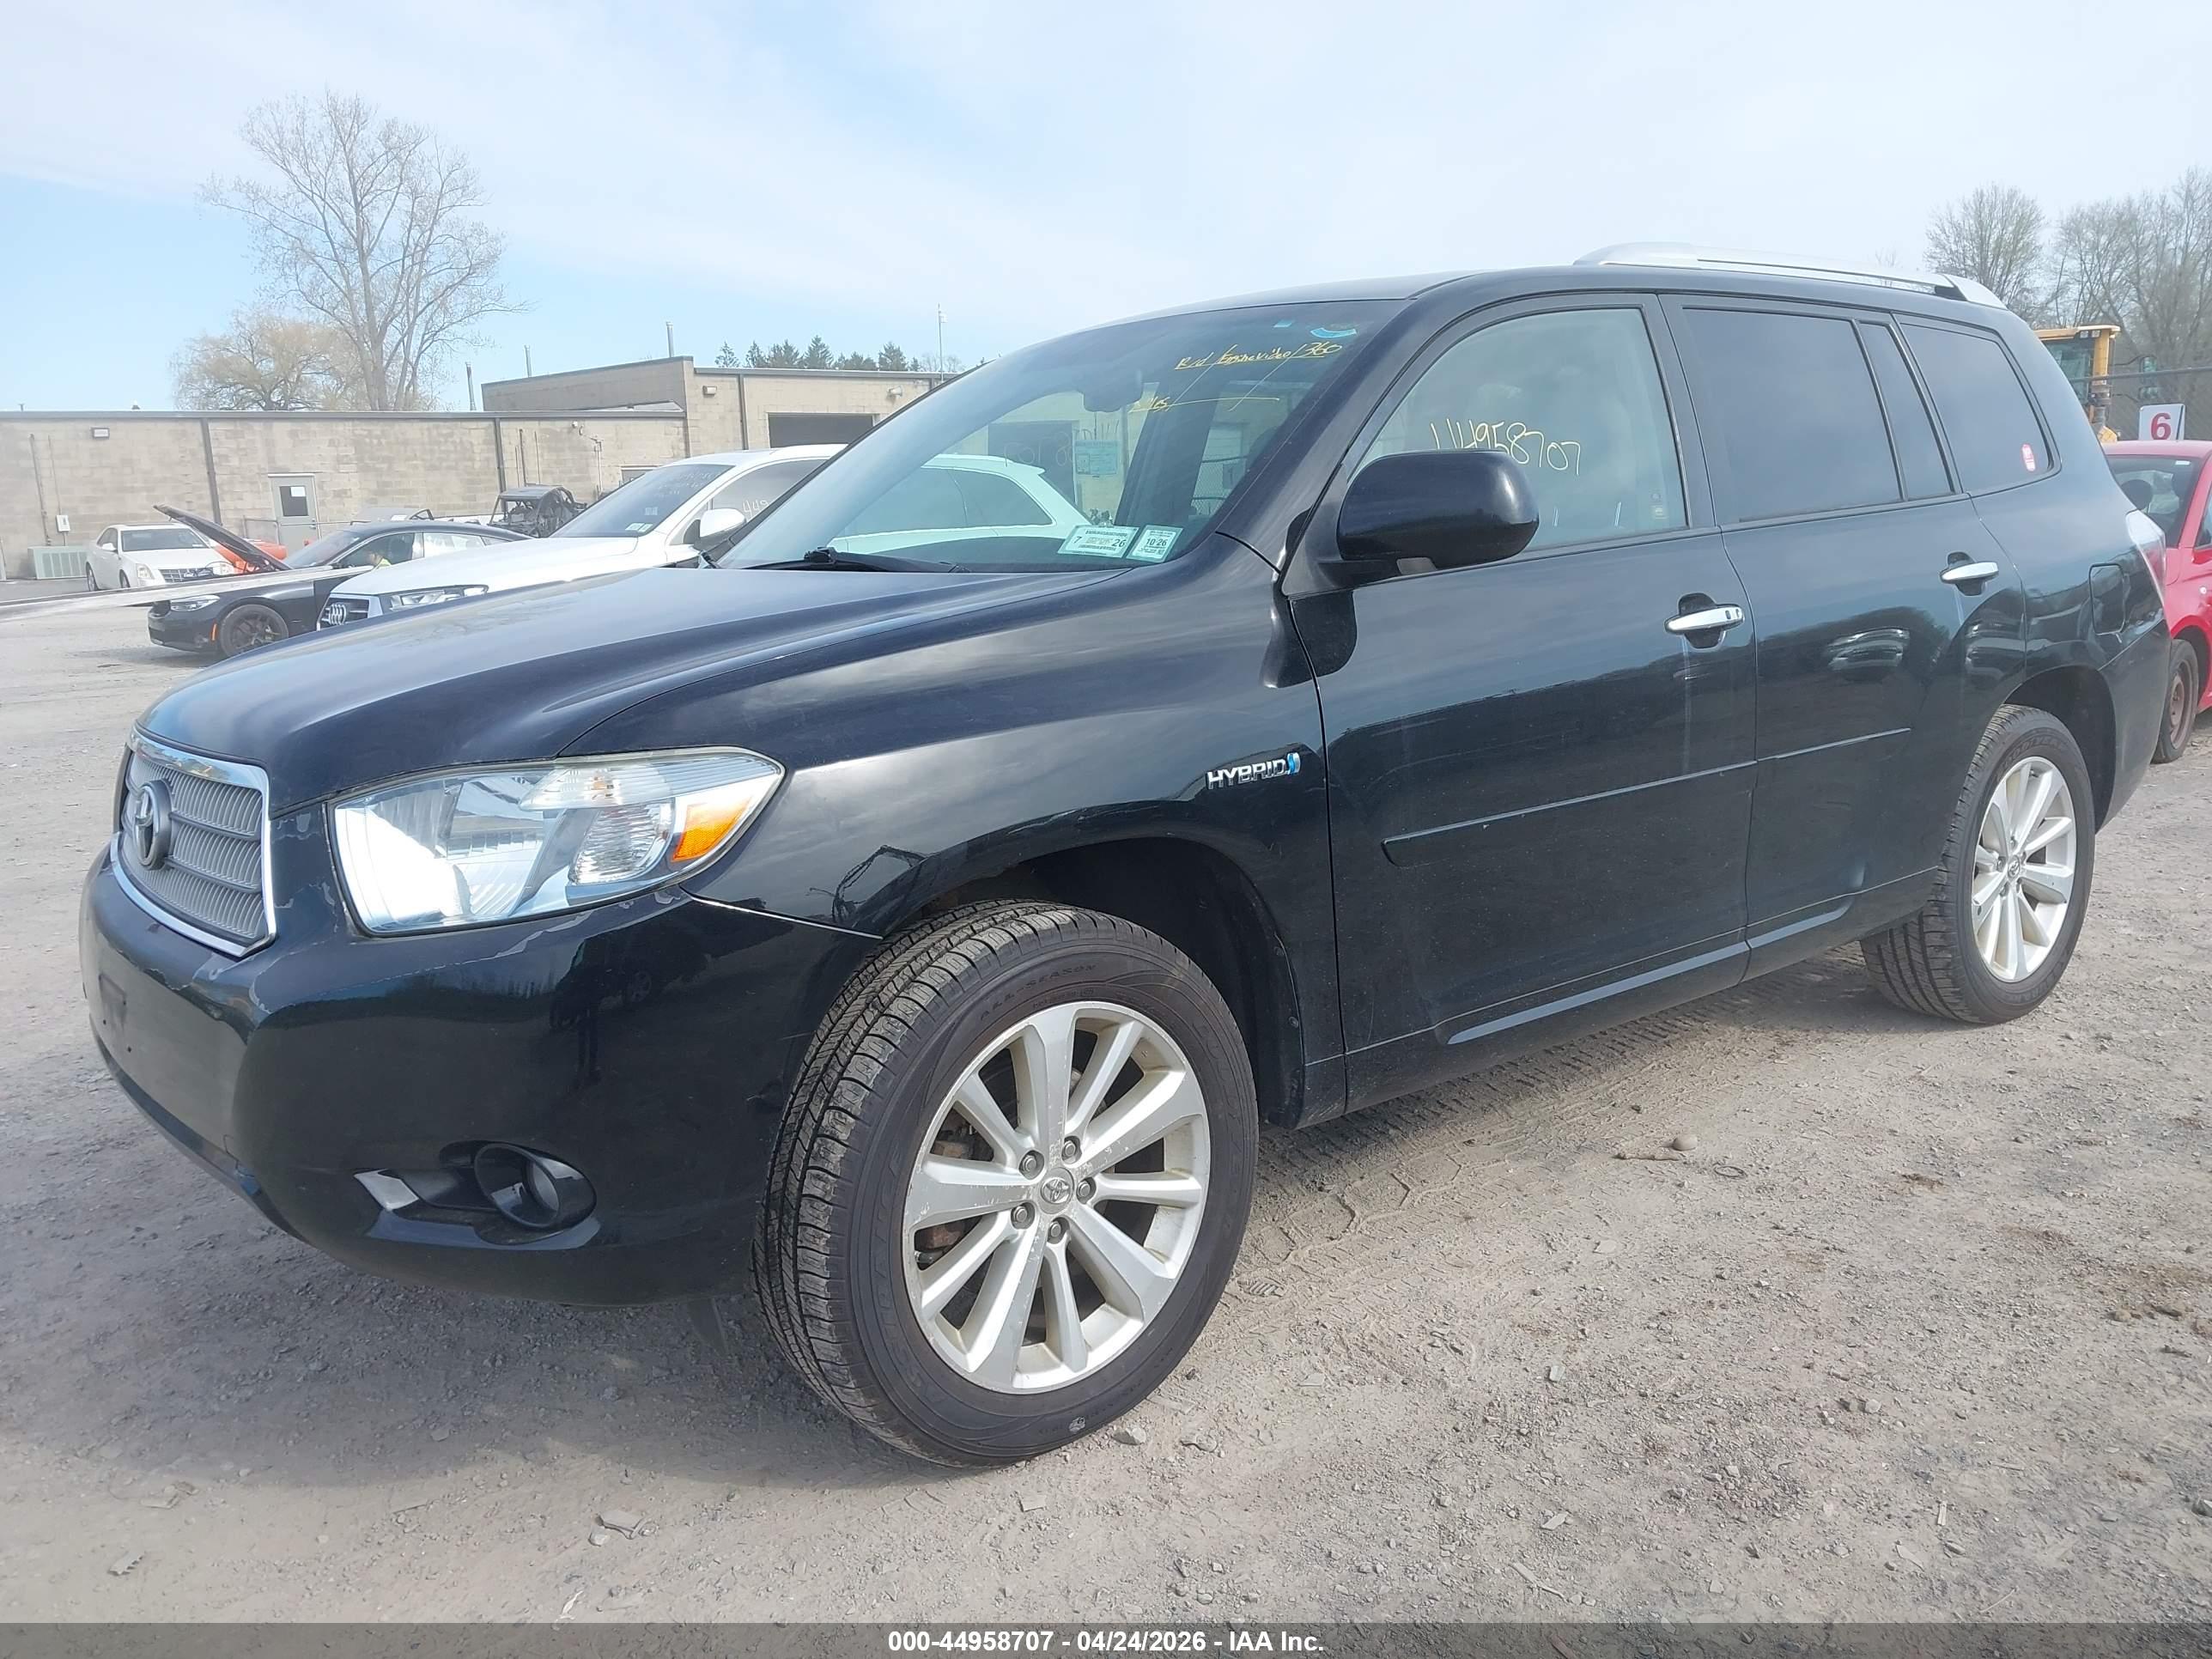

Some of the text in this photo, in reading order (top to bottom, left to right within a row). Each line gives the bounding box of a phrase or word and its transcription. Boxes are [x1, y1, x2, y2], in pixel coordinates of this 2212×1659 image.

[2150, 412, 2172, 440] 6
[1111, 538, 1127, 548] 26
[1206, 759, 1288, 789] HYBRID
